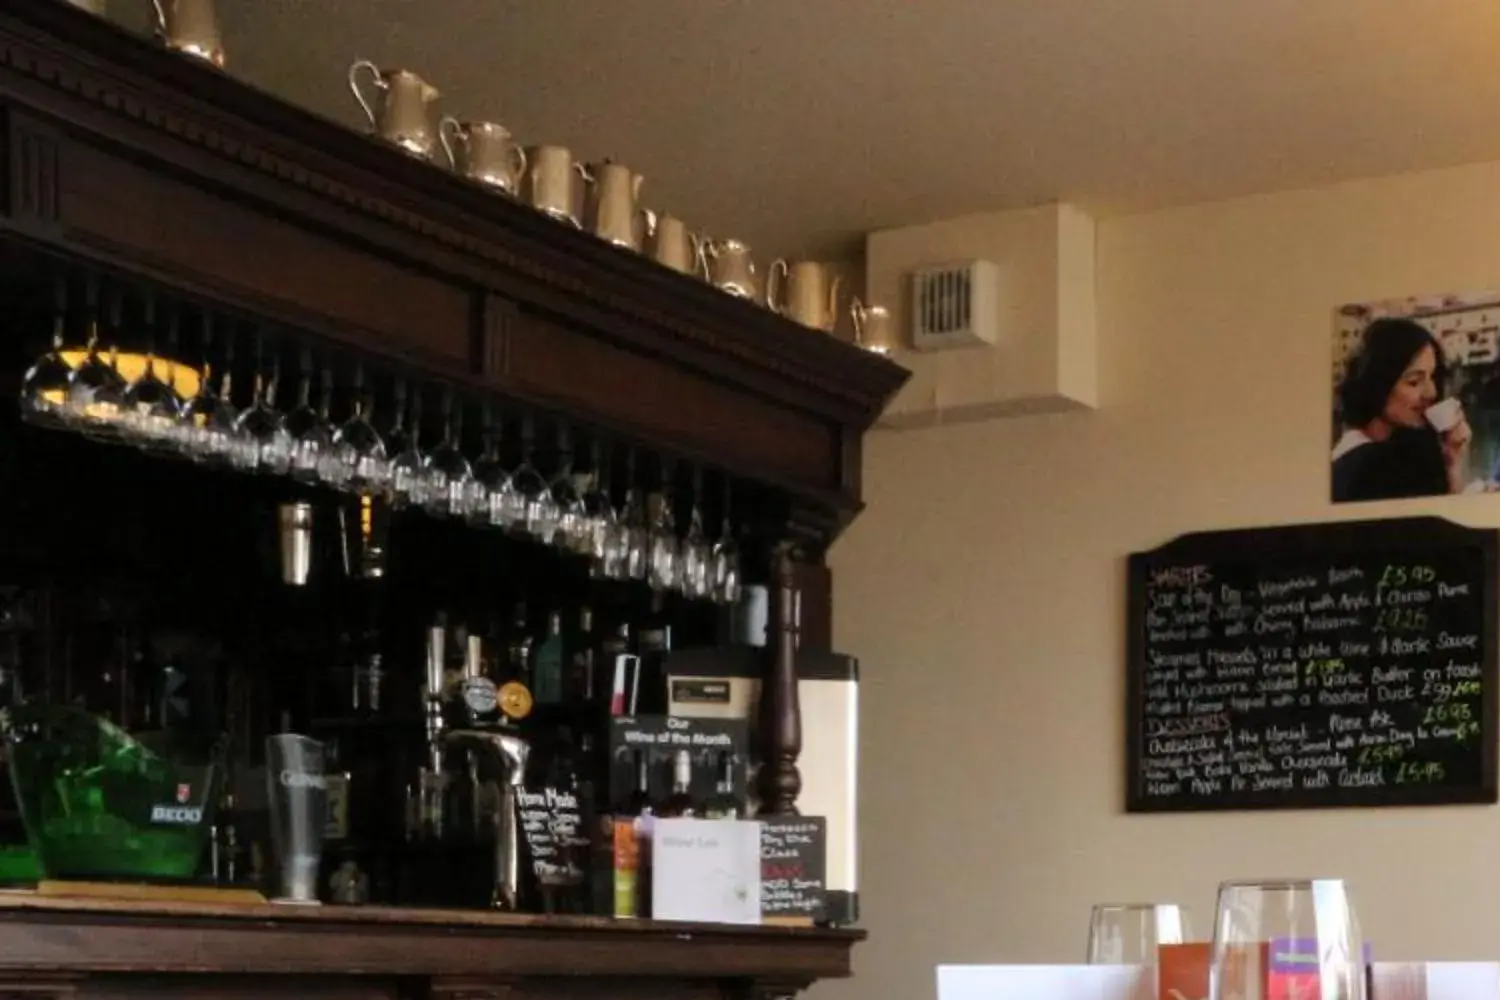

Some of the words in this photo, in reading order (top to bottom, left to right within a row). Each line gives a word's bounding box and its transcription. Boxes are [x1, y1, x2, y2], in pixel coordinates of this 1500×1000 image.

[1377, 685, 1415, 702] Duck
[667, 717, 690, 729] Our
[625, 731, 655, 743] Wine
[657, 731, 670, 742] of
[672, 731, 690, 744] the
[693, 733, 732, 745] Month
